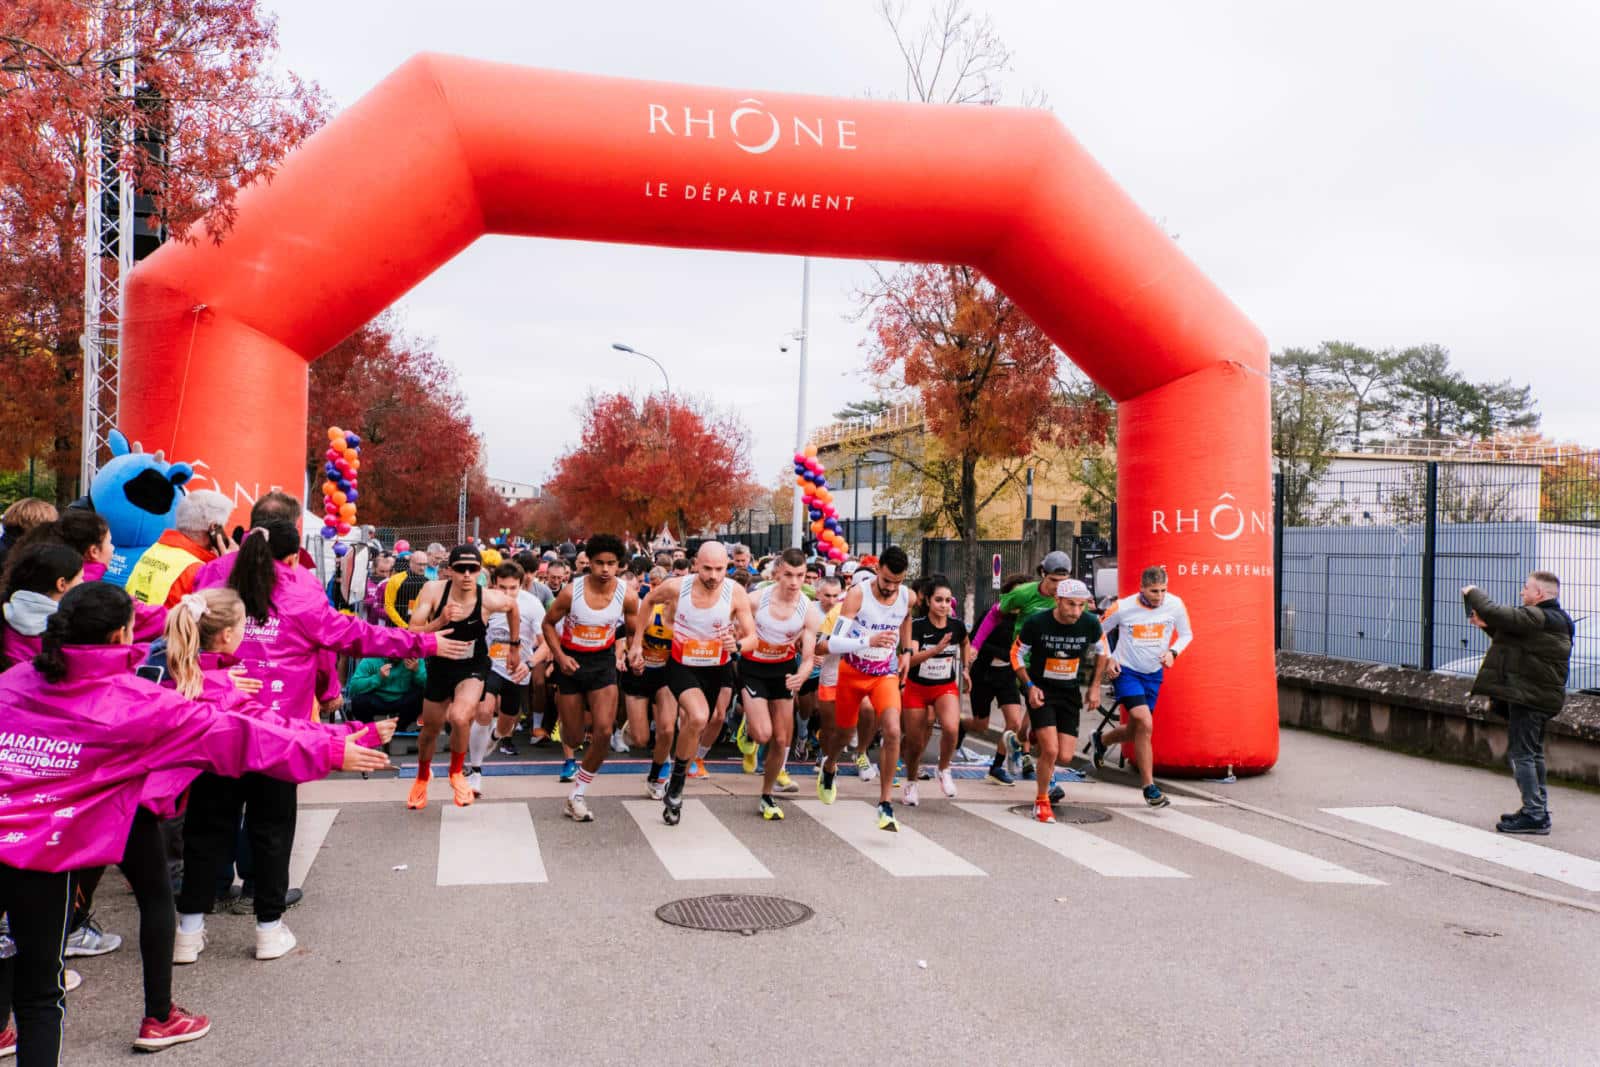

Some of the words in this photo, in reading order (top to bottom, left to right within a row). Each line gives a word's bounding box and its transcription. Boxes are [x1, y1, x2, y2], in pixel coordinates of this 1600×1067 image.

[648, 98, 857, 154] RHÔNE
[645, 181, 669, 198] LE
[684, 183, 855, 211] DÉPARTEMENT
[0, 749, 79, 769] Beaujolais
